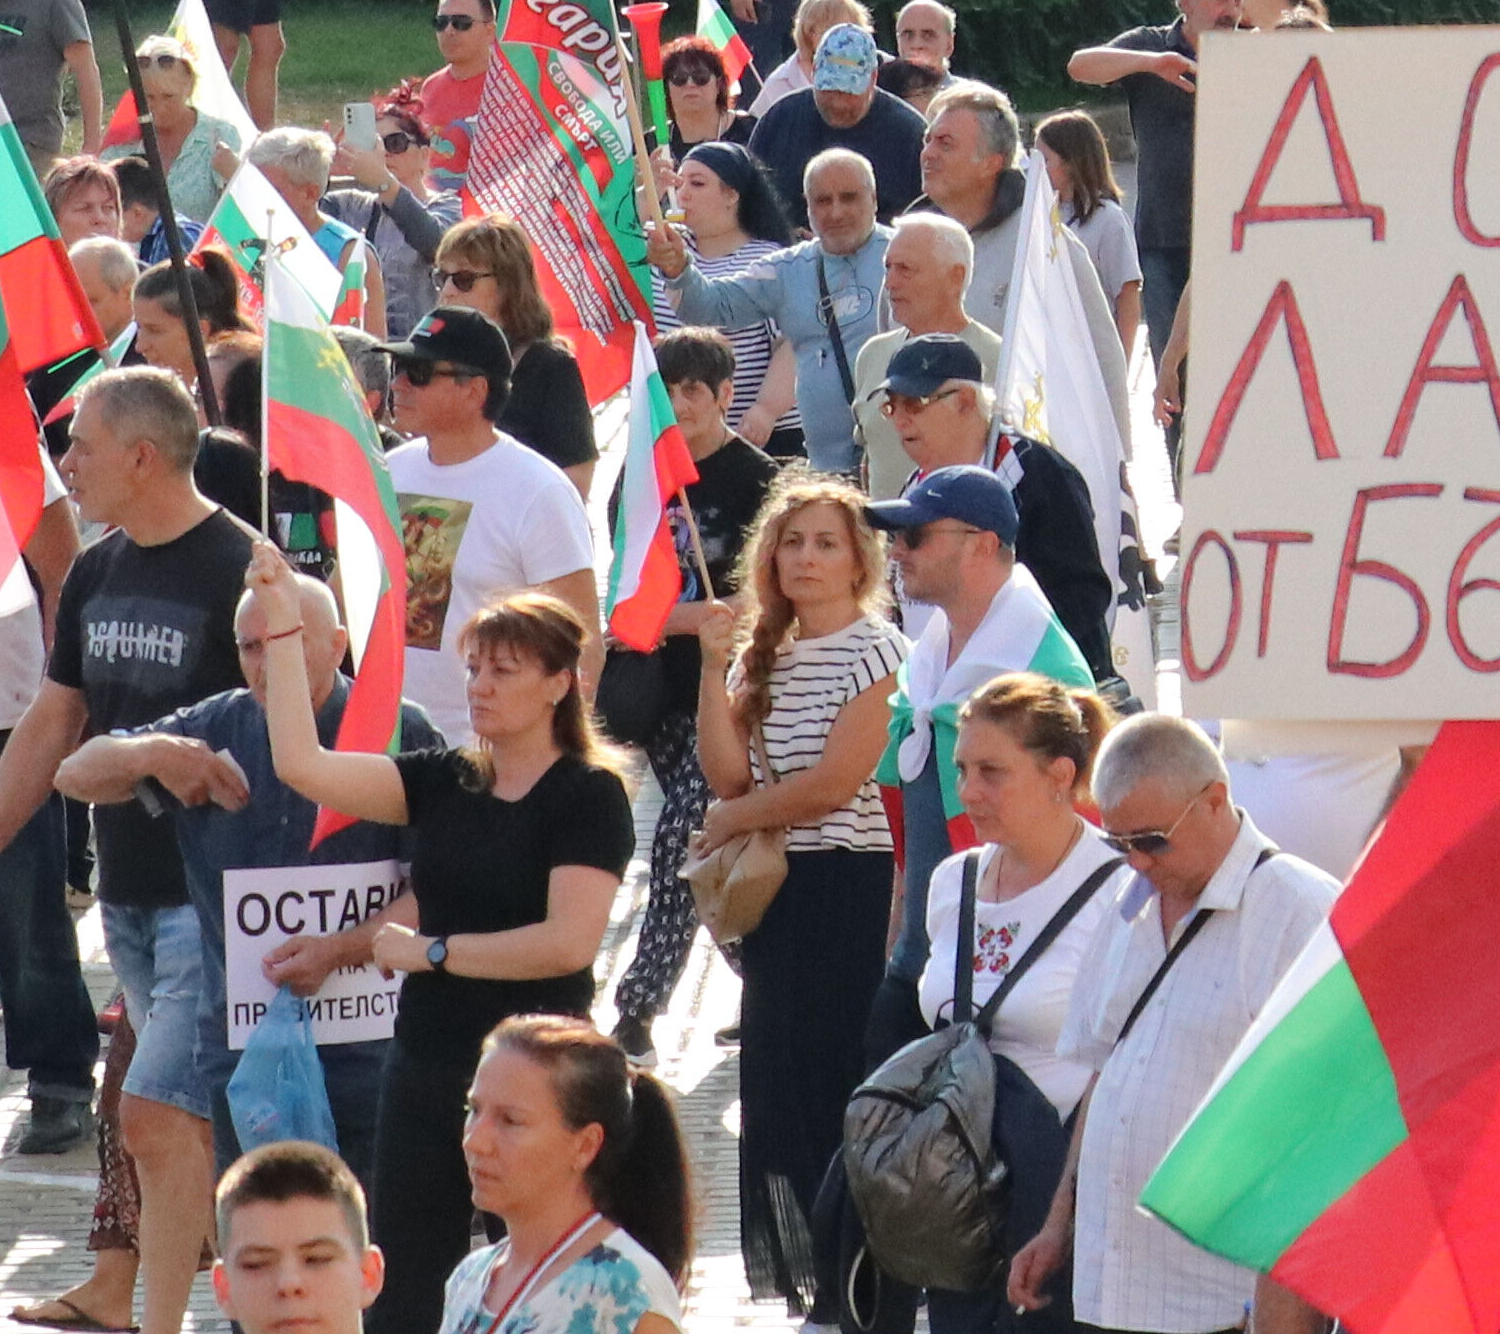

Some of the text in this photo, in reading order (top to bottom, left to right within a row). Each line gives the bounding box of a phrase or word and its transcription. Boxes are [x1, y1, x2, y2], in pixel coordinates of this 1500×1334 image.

[549, 62, 630, 165] СВОБОДА ИЛИ
[555, 104, 599, 152] СМЪРТ
[1180, 528, 1314, 684] ОТ
